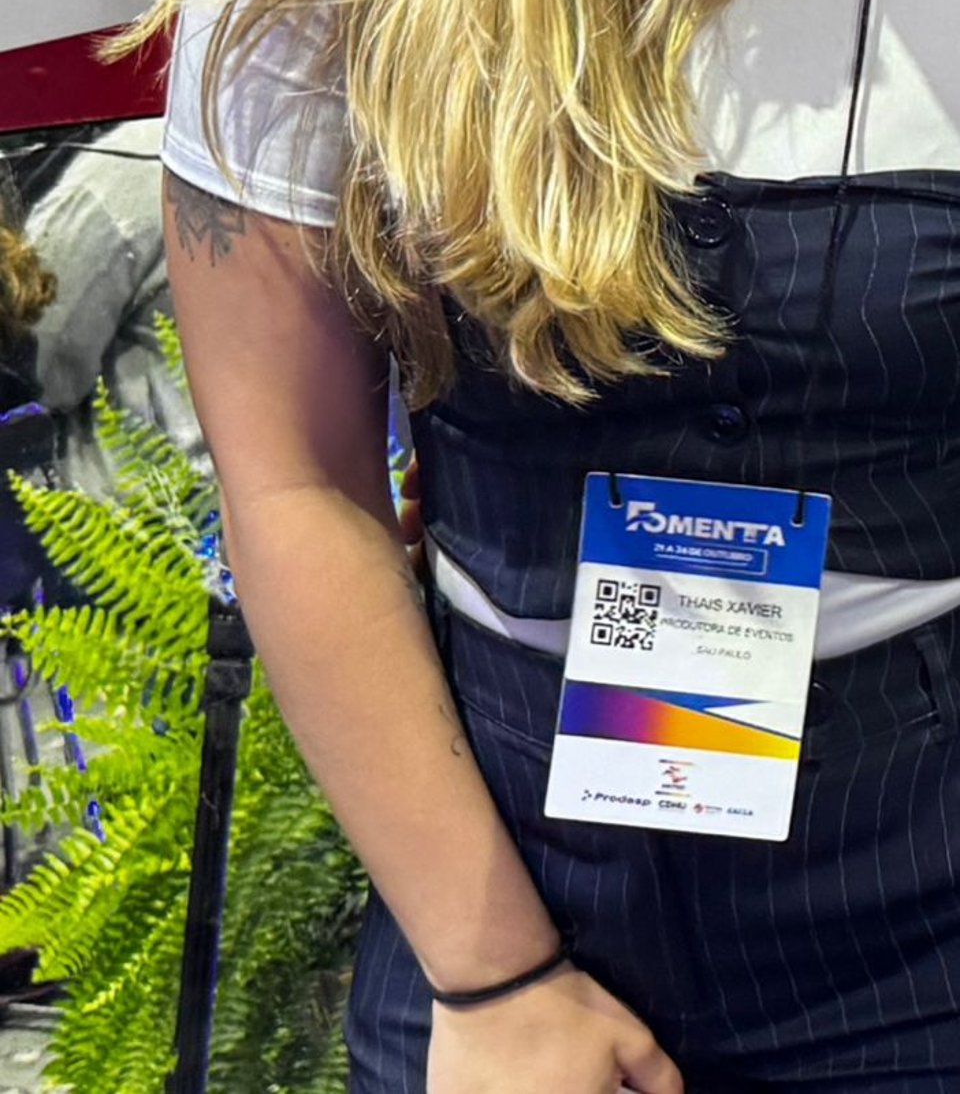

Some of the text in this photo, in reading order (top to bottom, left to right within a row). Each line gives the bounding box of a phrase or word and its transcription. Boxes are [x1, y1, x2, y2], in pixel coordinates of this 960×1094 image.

[626, 500, 786, 546] FOMENTTA
[678, 594, 783, 619] THAIS XAVIER
[727, 626, 742, 636] DE
[744, 627, 794, 643] EVENTOS
